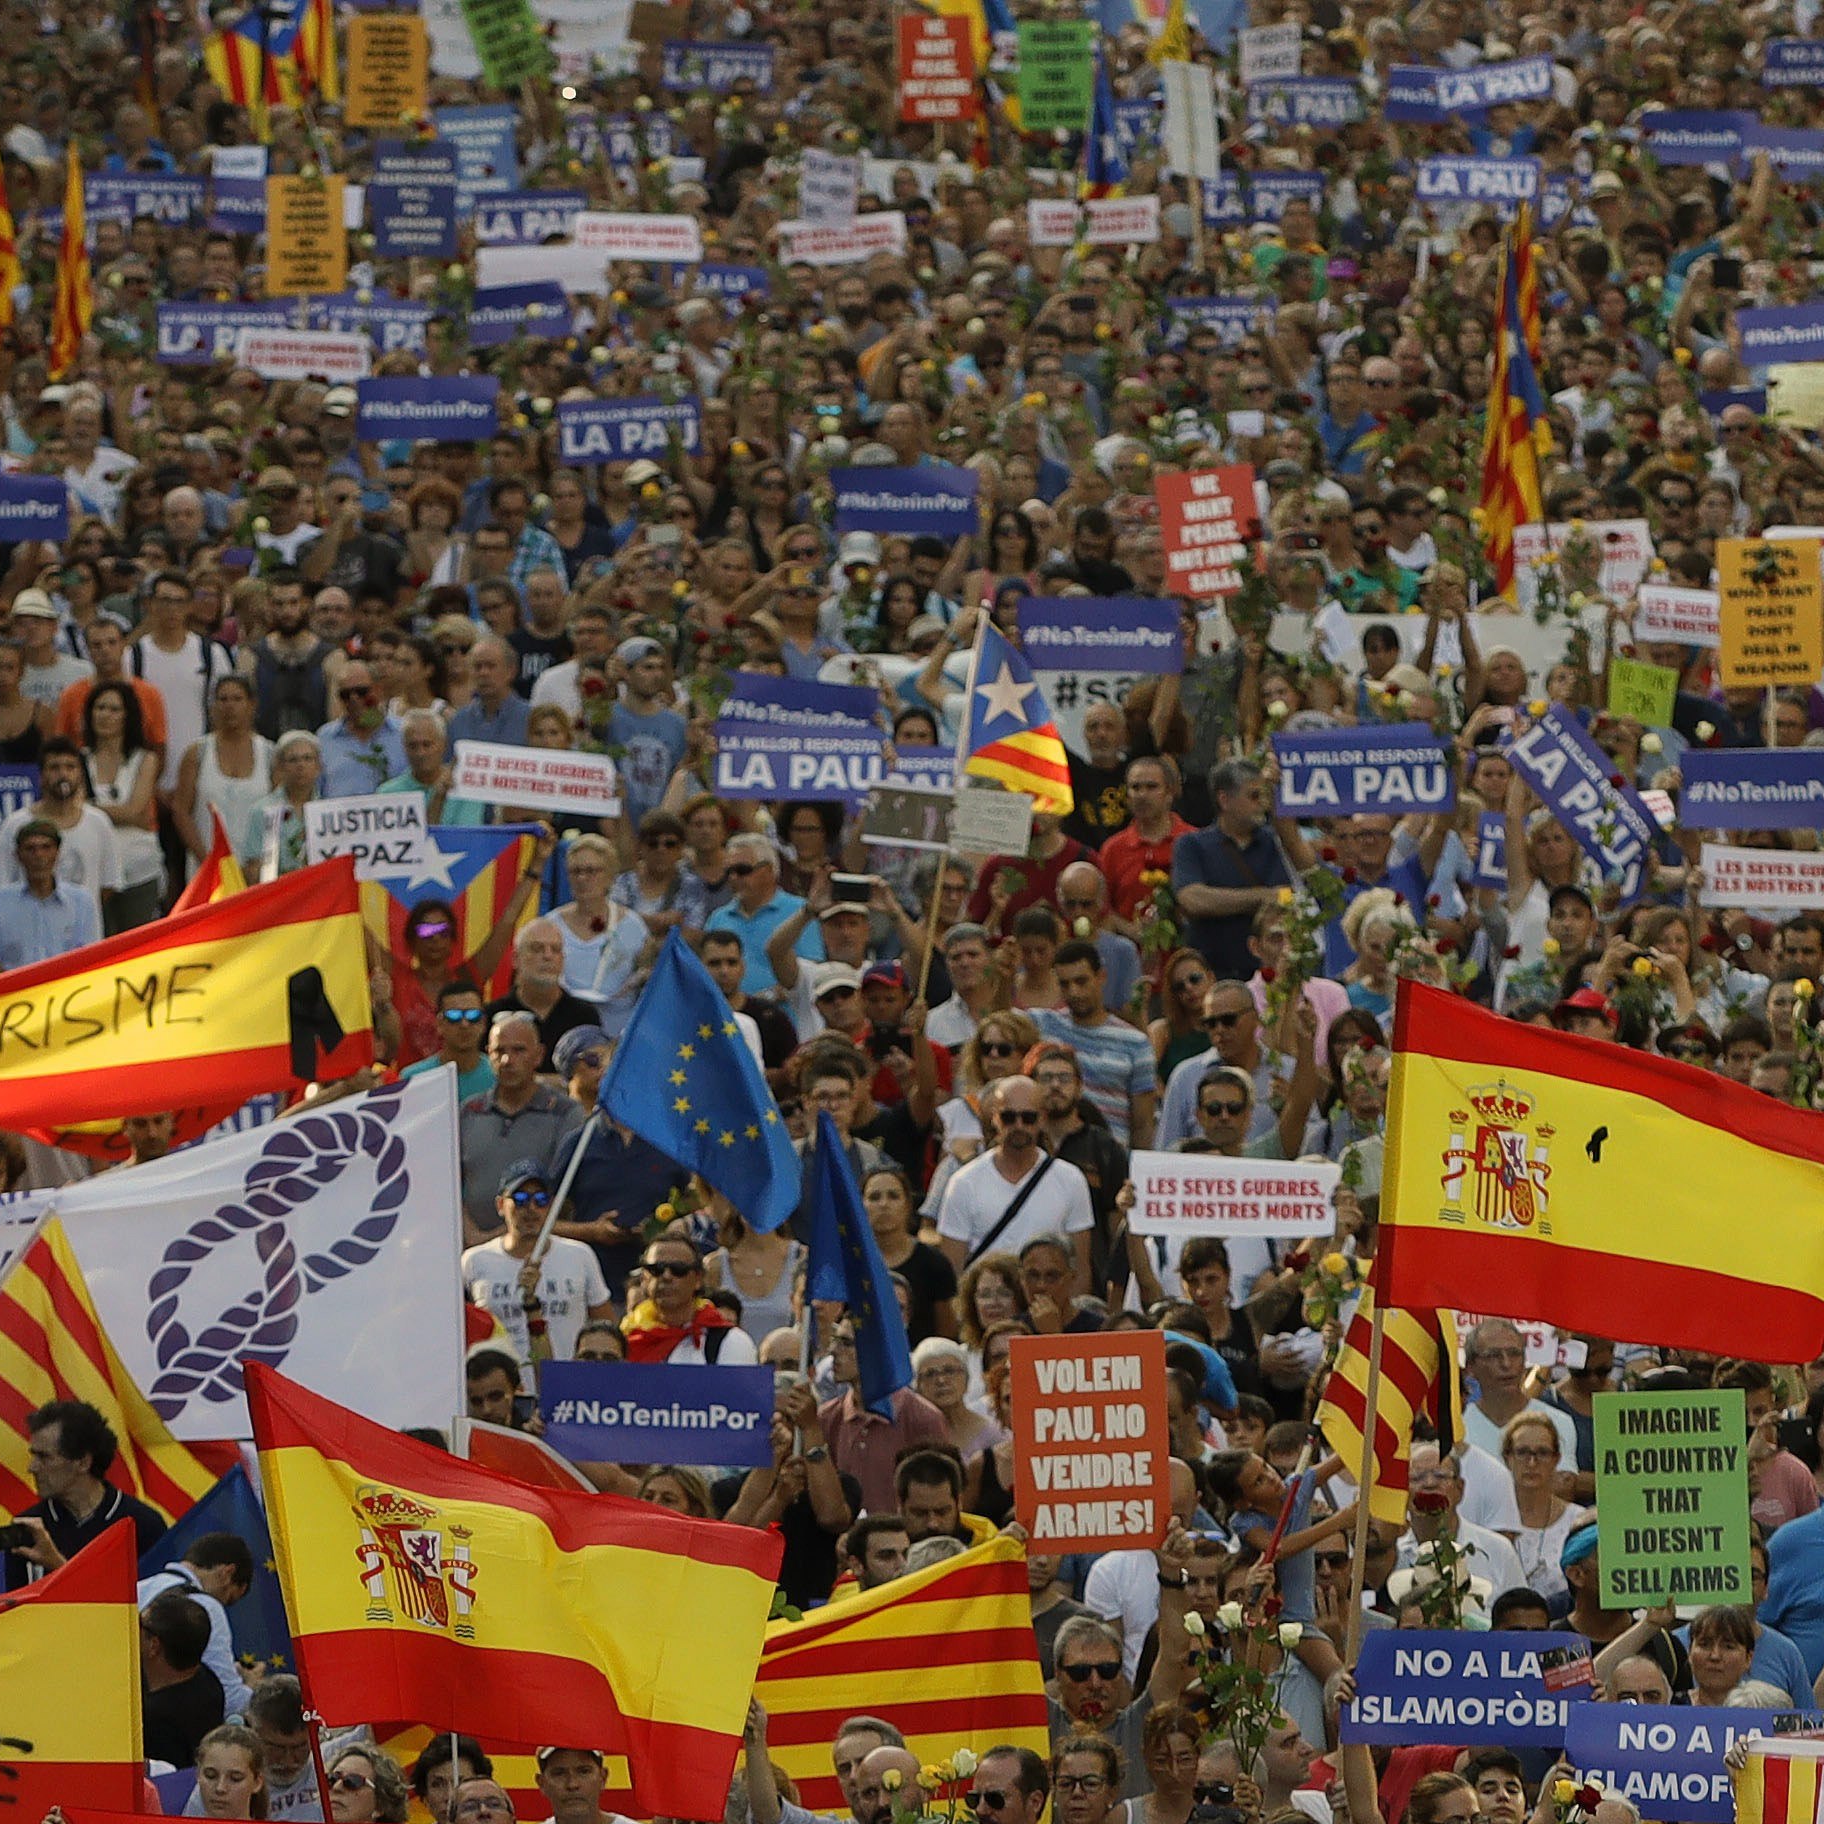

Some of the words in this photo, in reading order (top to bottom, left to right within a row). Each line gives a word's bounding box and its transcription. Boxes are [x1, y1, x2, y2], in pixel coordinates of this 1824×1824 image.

[720, 756, 775, 789] LA
[789, 755, 880, 789] PAU
[1281, 768, 1346, 804] LA
[1353, 766, 1447, 802] PAU
[315, 807, 420, 837] JUSTICIA
[353, 837, 424, 868] PAZ.
[1034, 1356, 1143, 1396] VOLEM
[1033, 1405, 1099, 1444] PAU,
[1103, 1405, 1147, 1441] NO
[1617, 1406, 1722, 1436] IMAGINE
[1029, 1453, 1154, 1492] VENDRE
[1603, 1448, 1621, 1475] A
[1625, 1445, 1739, 1475] COUNTRY
[1642, 1487, 1702, 1515] THAT
[1031, 1499, 1155, 1539] ARMES!
[1623, 1525, 1724, 1555] DOESN'T
[1610, 1567, 1671, 1595] SELL
[1674, 1566, 1742, 1594] ARMS
